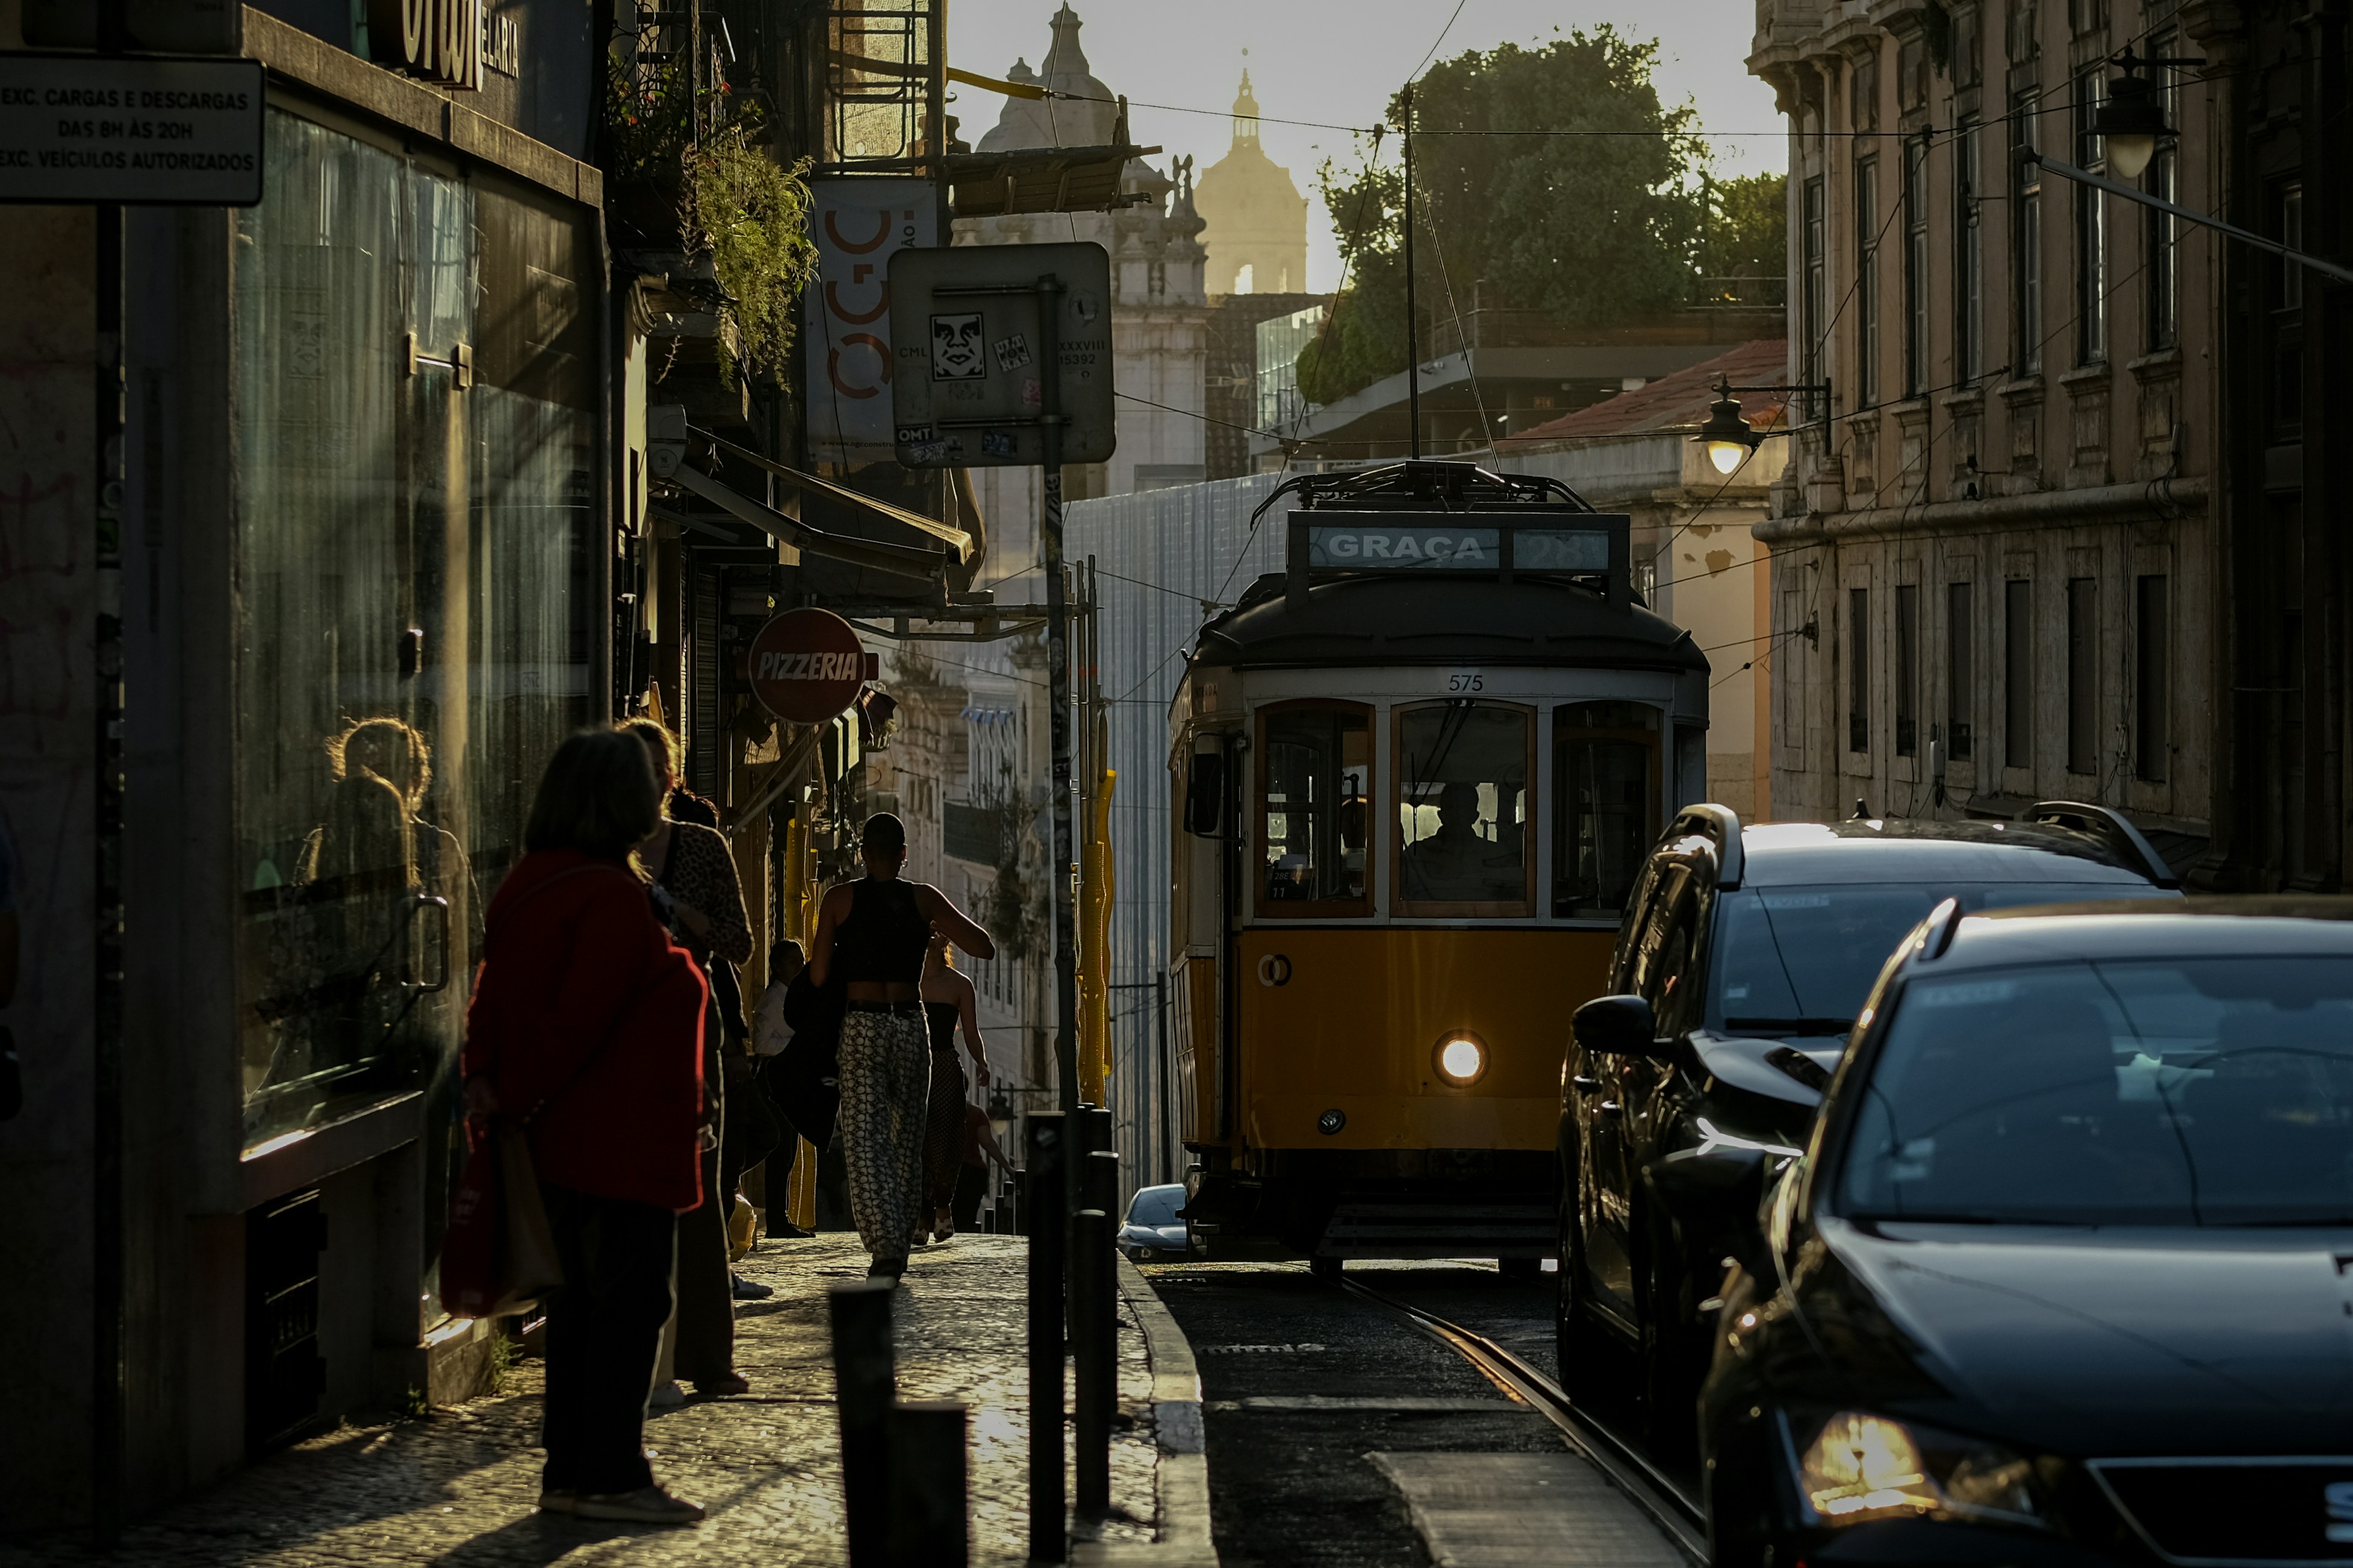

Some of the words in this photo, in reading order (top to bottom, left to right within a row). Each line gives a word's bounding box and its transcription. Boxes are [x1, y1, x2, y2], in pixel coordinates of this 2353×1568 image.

[2, 88, 39, 106] EXC.
[46, 89, 119, 107] CARGAS
[126, 91, 134, 107] E
[142, 91, 248, 110] DESCARGAS
[59, 120, 93, 137] DAS
[101, 121, 123, 138] 8H
[129, 116, 152, 138] ÀS
[158, 122, 193, 139] 20H
[39, 148, 126, 169] VEÍCULOS
[132, 152, 253, 171] AUTORIZADOS
[825, 211, 893, 400] OGC
[900, 347, 928, 358] CML
[1059, 340, 1104, 351] XXXVIII
[1060, 354, 1095, 365] 15392
[898, 427, 931, 442] OMT
[1328, 534, 1485, 566] GRAÇA
[757, 651, 858, 681] PIZZERIA
[1449, 675, 1483, 692] 575
[1274, 872, 1289, 881] 28E
